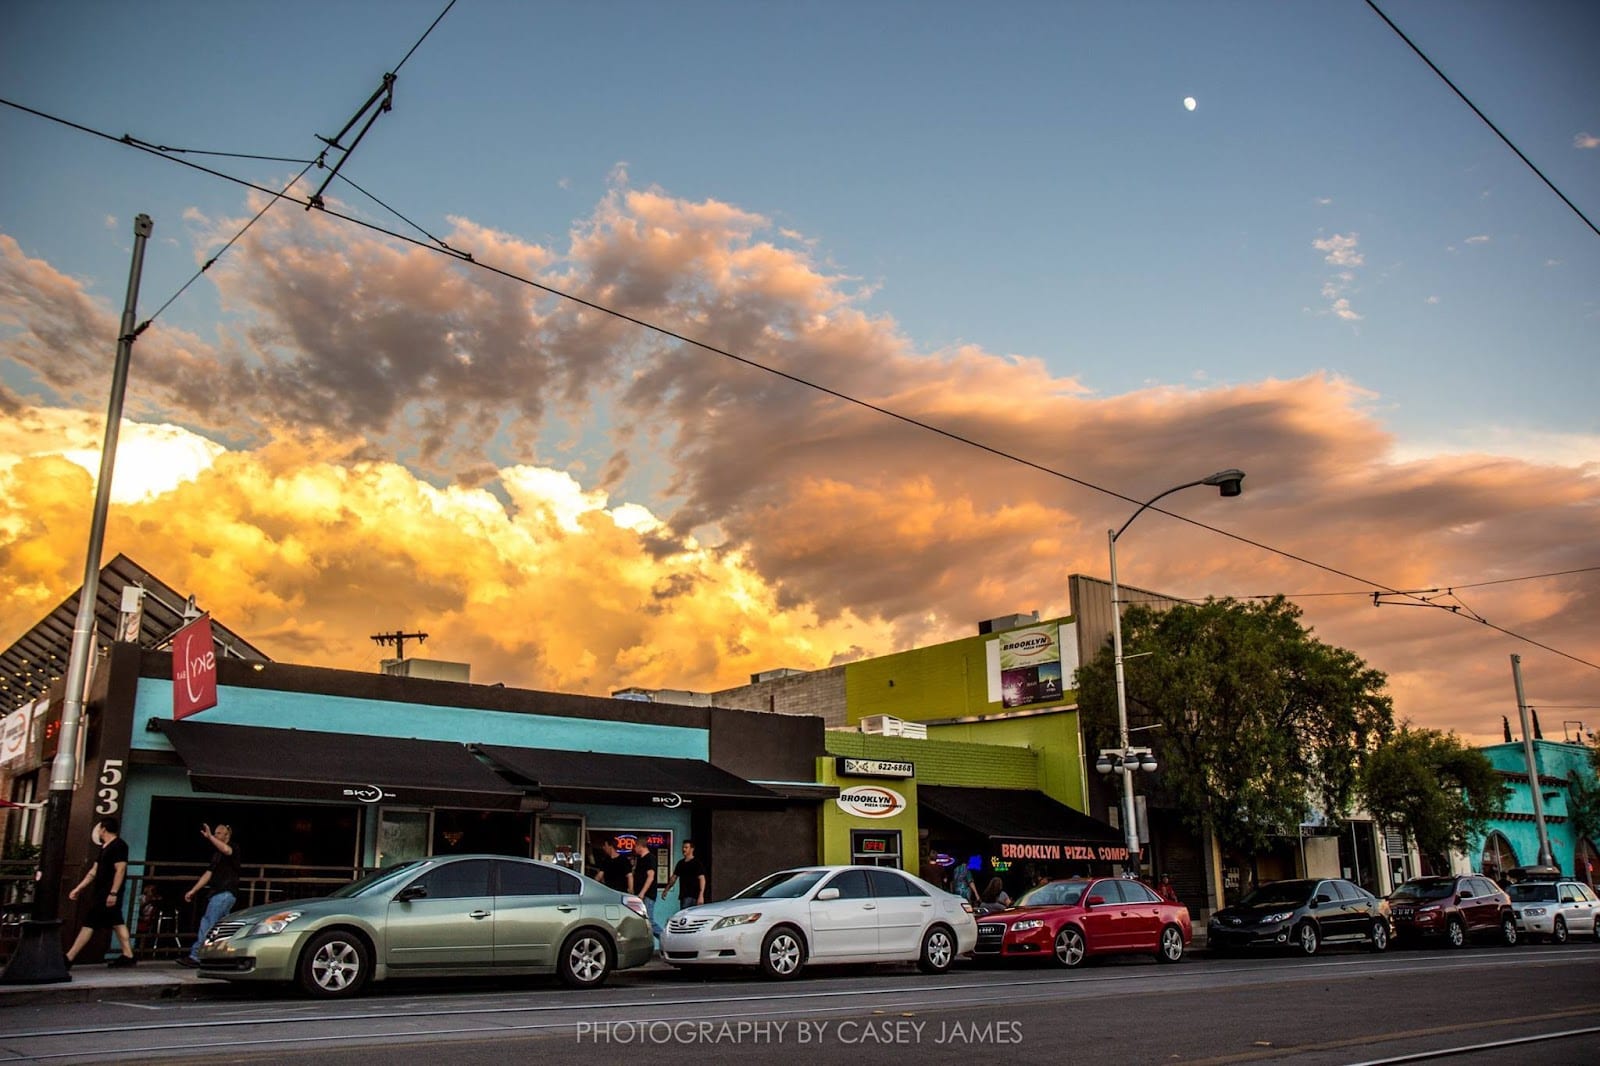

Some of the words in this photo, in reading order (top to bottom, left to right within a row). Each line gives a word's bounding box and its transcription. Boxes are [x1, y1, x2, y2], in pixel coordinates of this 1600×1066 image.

[1003, 637, 1047, 651] BROOKLYN
[343, 789, 376, 797] SKY
[841, 794, 891, 803] BROOKLYN
[865, 841, 883, 851] OPEN
[1001, 843, 1060, 860] BROOKLYN
[1064, 845, 1096, 860] PIZZA
